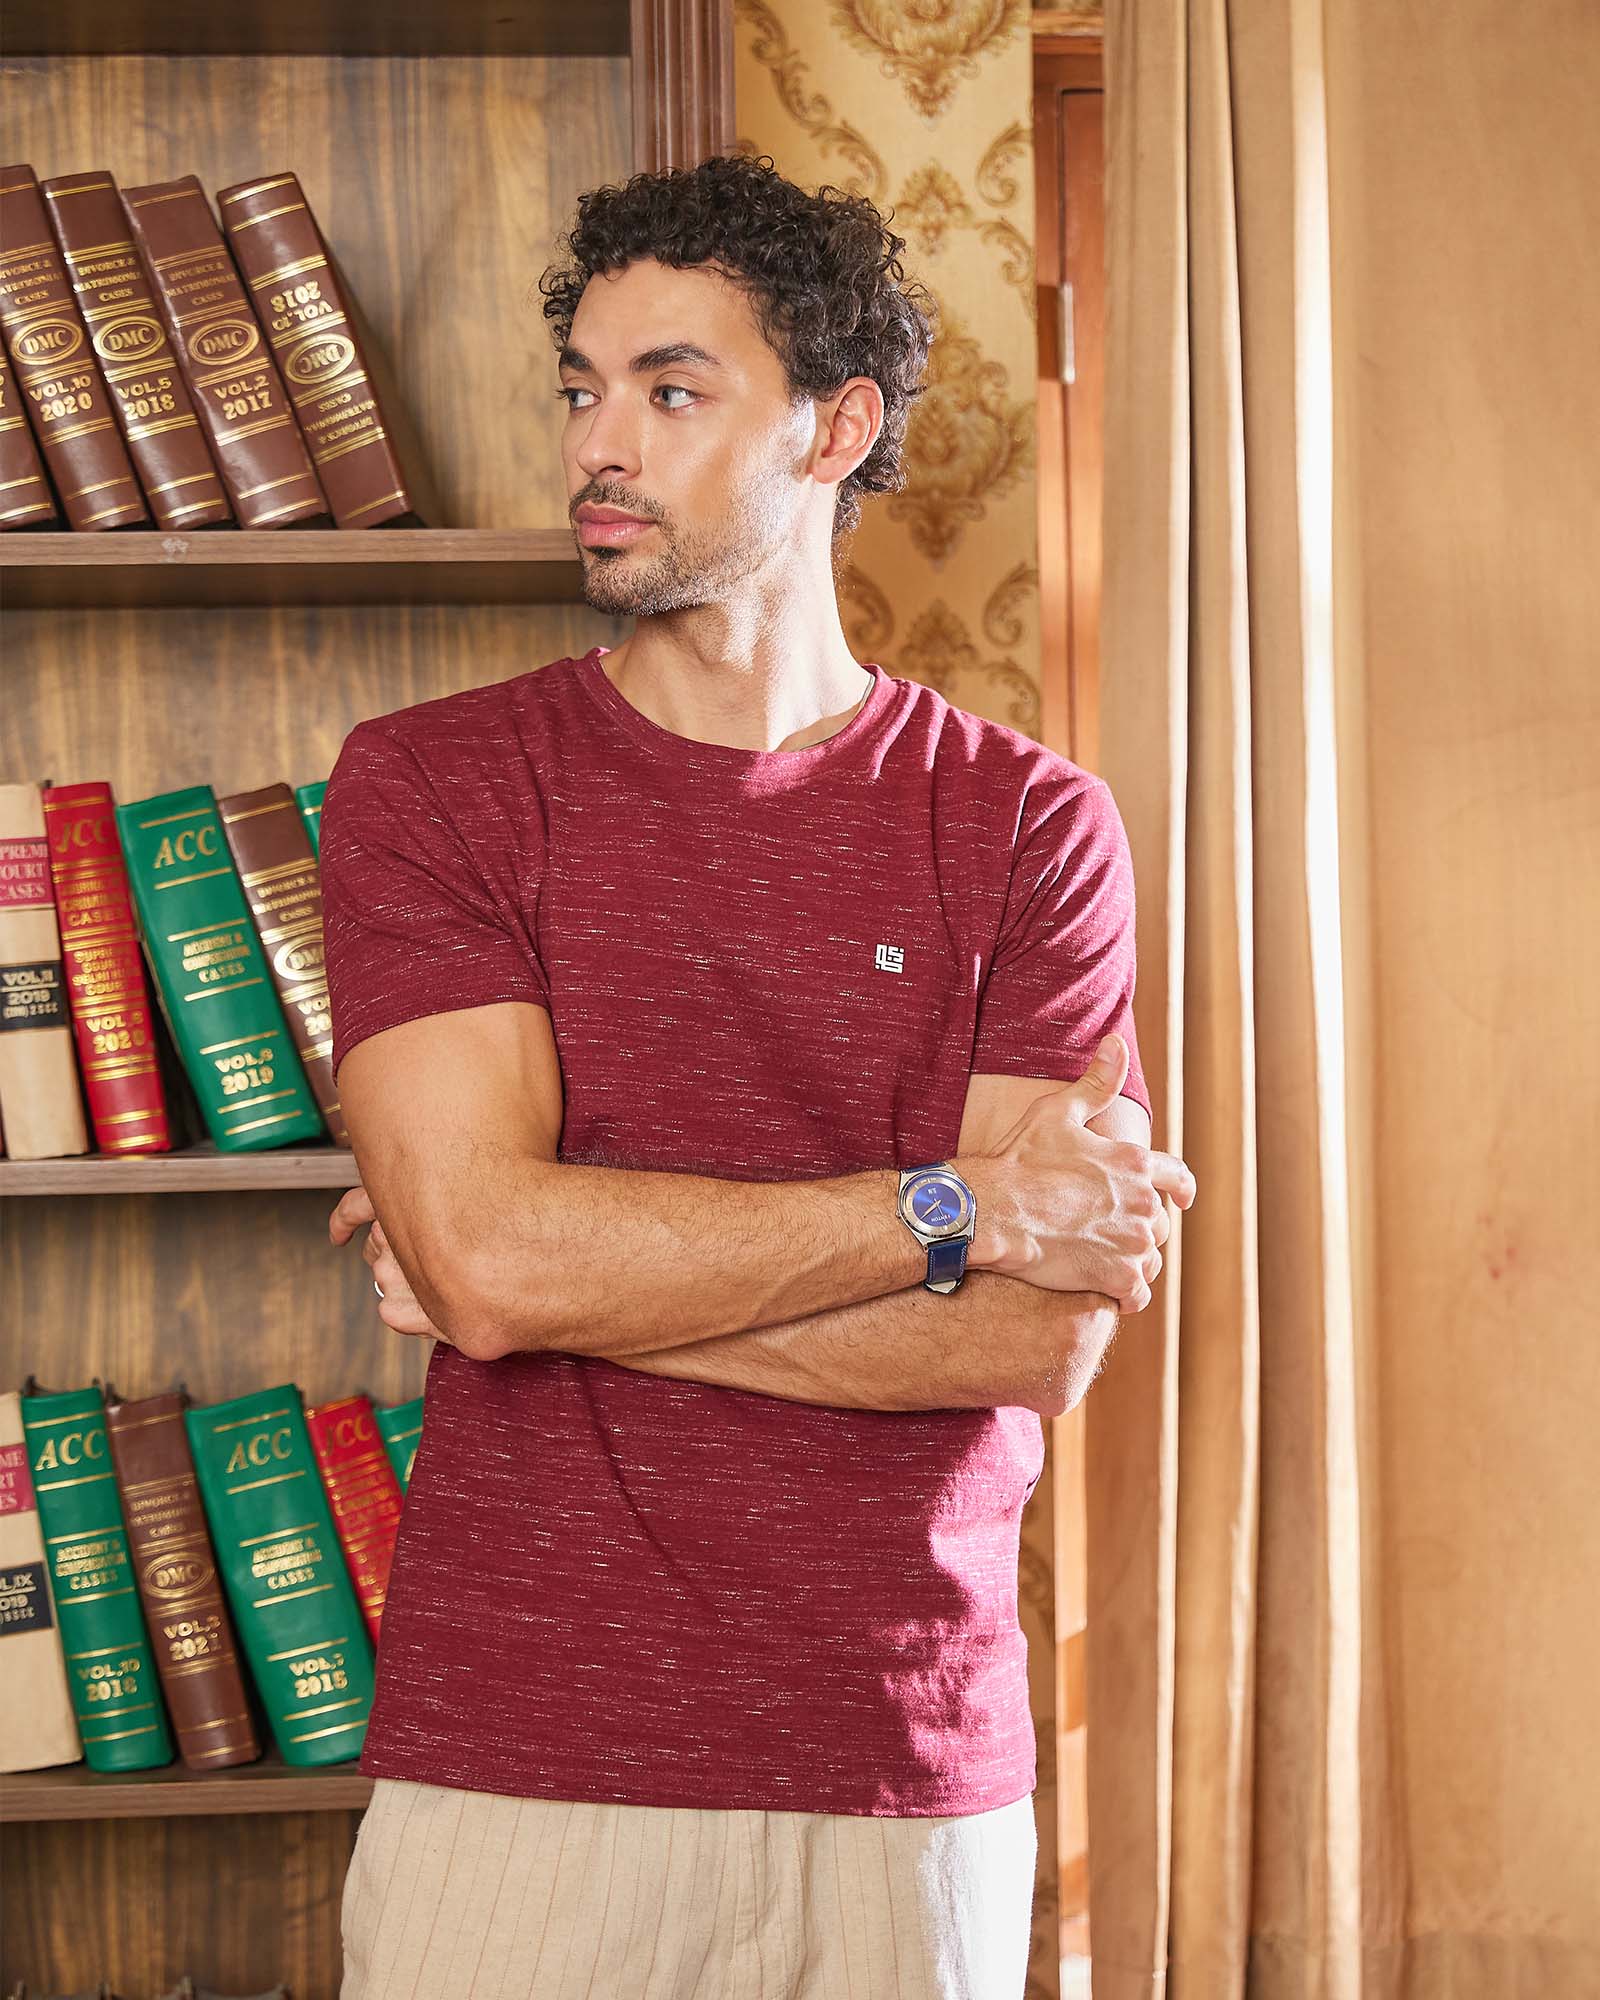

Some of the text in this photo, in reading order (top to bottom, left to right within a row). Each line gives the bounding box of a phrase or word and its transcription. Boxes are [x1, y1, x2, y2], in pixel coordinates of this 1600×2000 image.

[24, 329, 69, 354] DMC
[108, 326, 153, 351] DMC
[202, 330, 246, 355] DMC
[299, 343, 341, 374] DMC
[40, 392, 93, 422] 2020
[123, 393, 175, 421] 2018
[223, 391, 273, 420] 2017
[153, 825, 218, 869] ACC
[298, 996, 331, 1015] VO
[305, 1012, 332, 1036] 20
[34, 1429, 105, 1472] ACC
[225, 1427, 293, 1474] ACC
